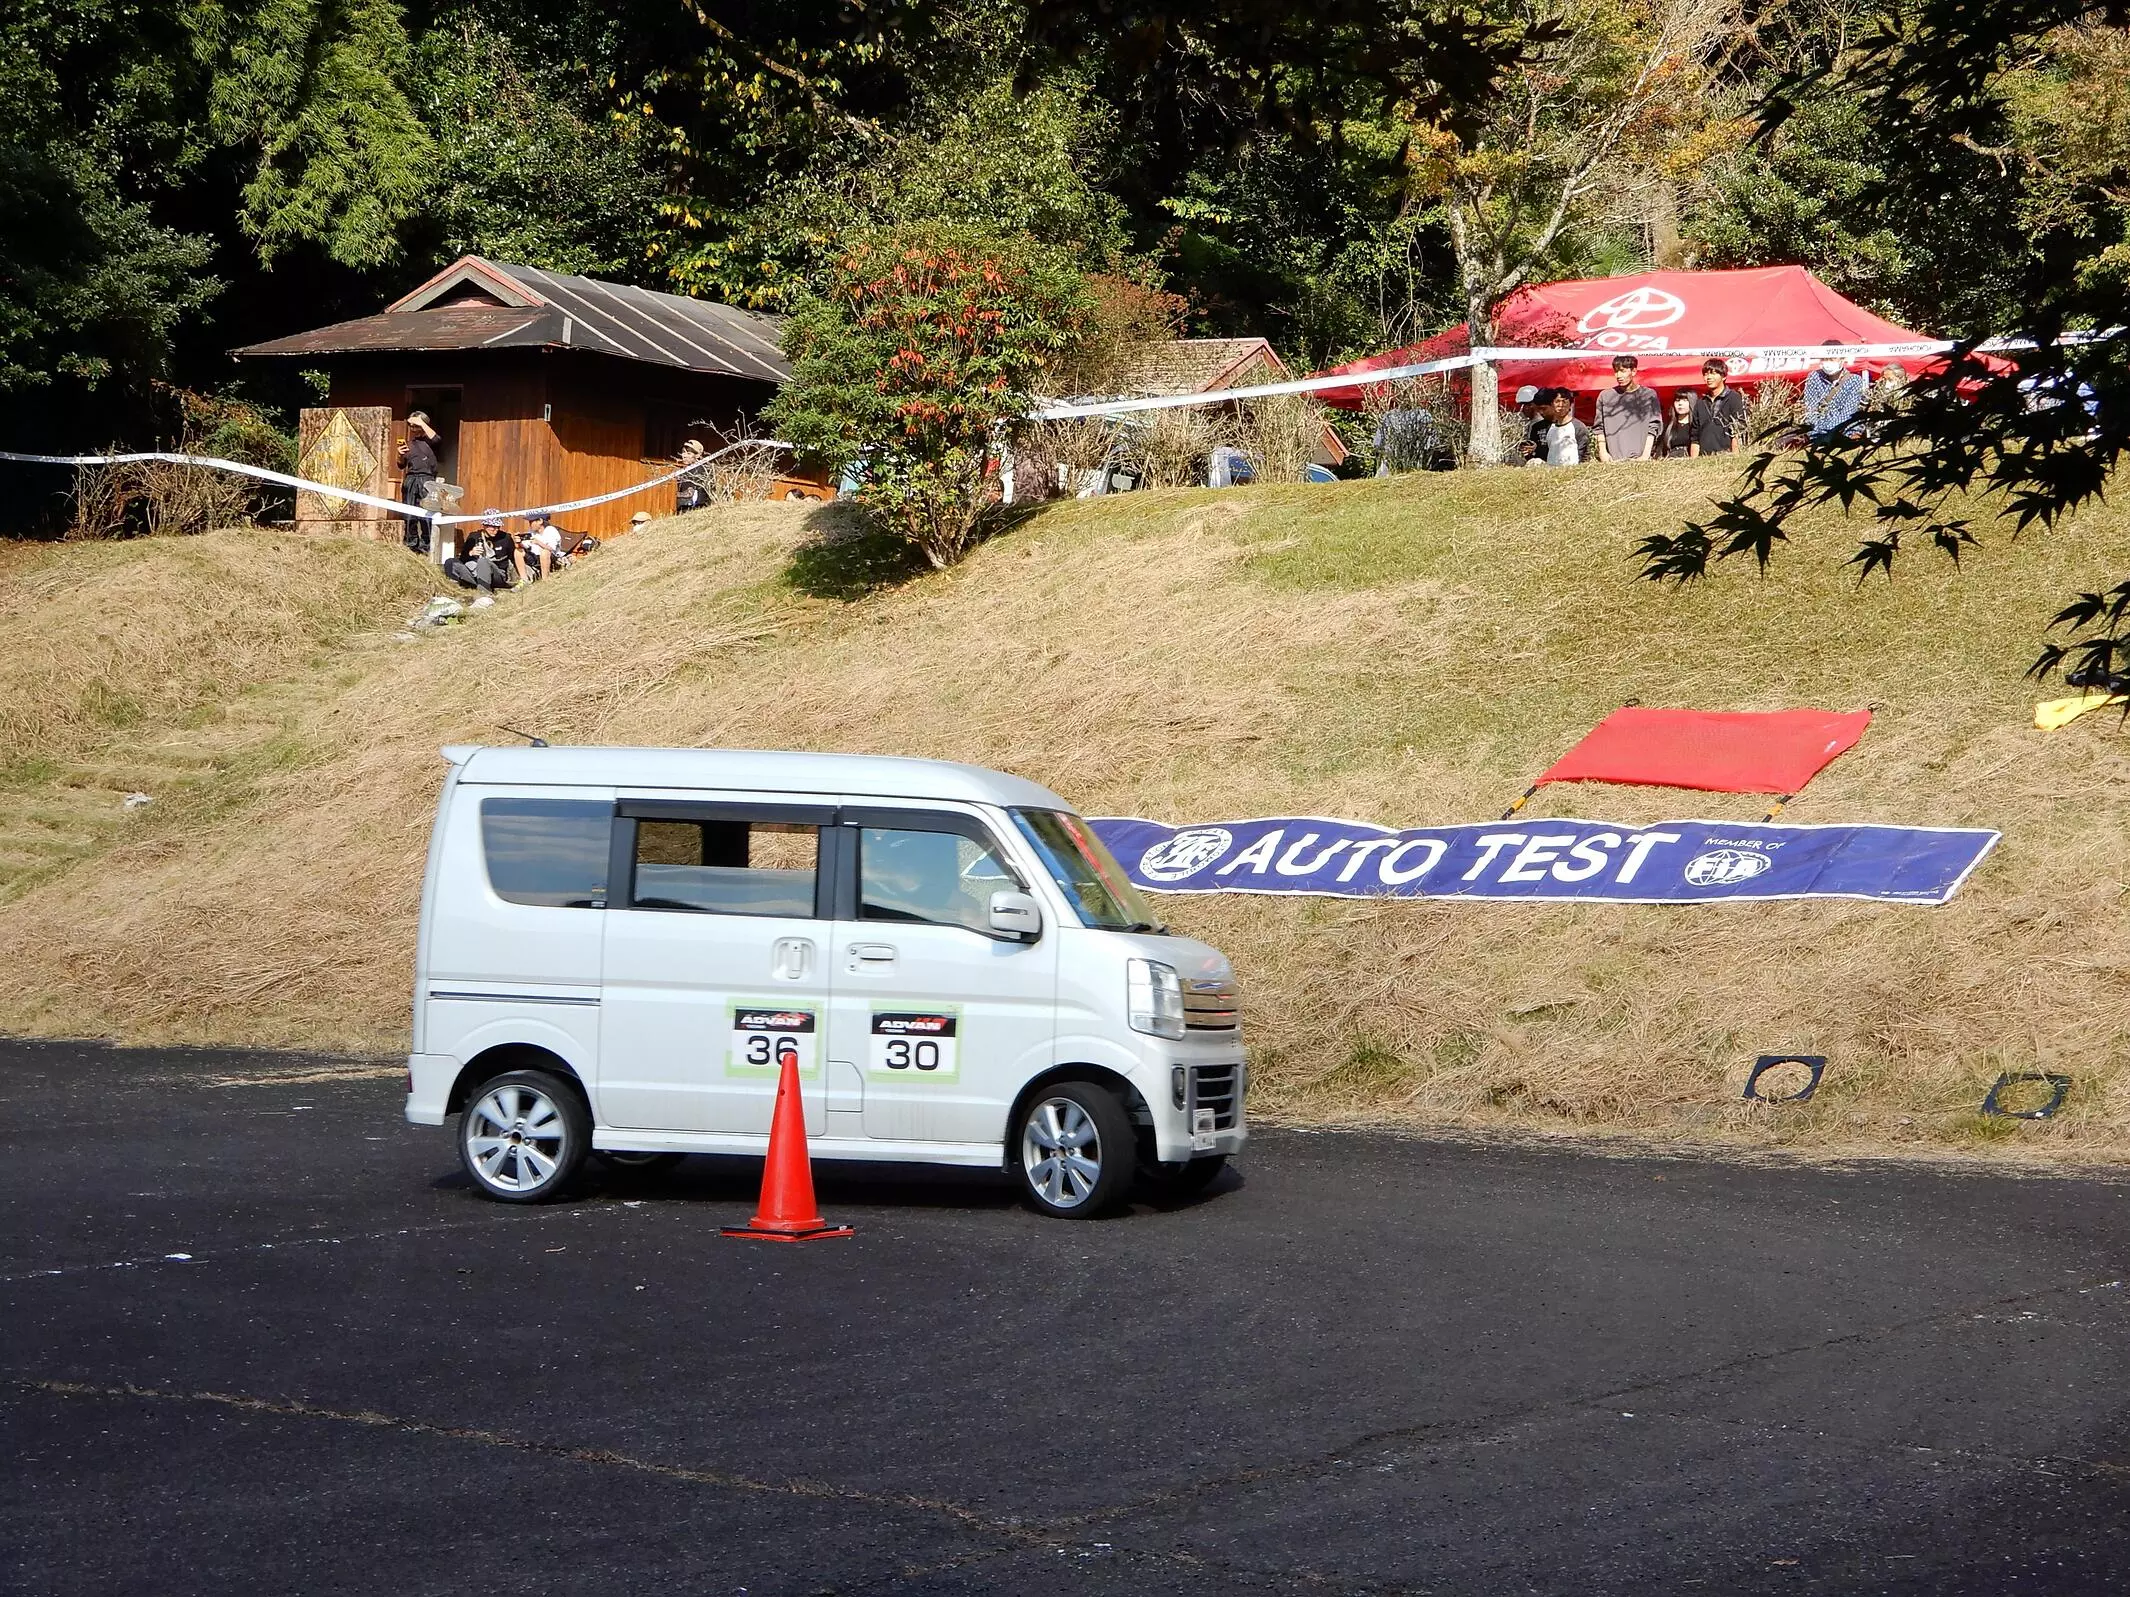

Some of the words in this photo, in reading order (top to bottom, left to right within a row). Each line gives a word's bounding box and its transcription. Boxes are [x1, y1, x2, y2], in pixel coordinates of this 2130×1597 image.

[1700, 349, 1745, 358] YOKOHAMA
[1763, 349, 1807, 357] YOKOHAMA
[1704, 838, 1763, 850] MEMBER
[1765, 842, 1787, 851] OF
[1216, 829, 1449, 885] AUTO
[1461, 832, 1682, 884] TEST
[740, 1015, 801, 1026] ADVAN
[878, 1019, 942, 1031] ADVAN
[886, 1039, 940, 1071] 30
